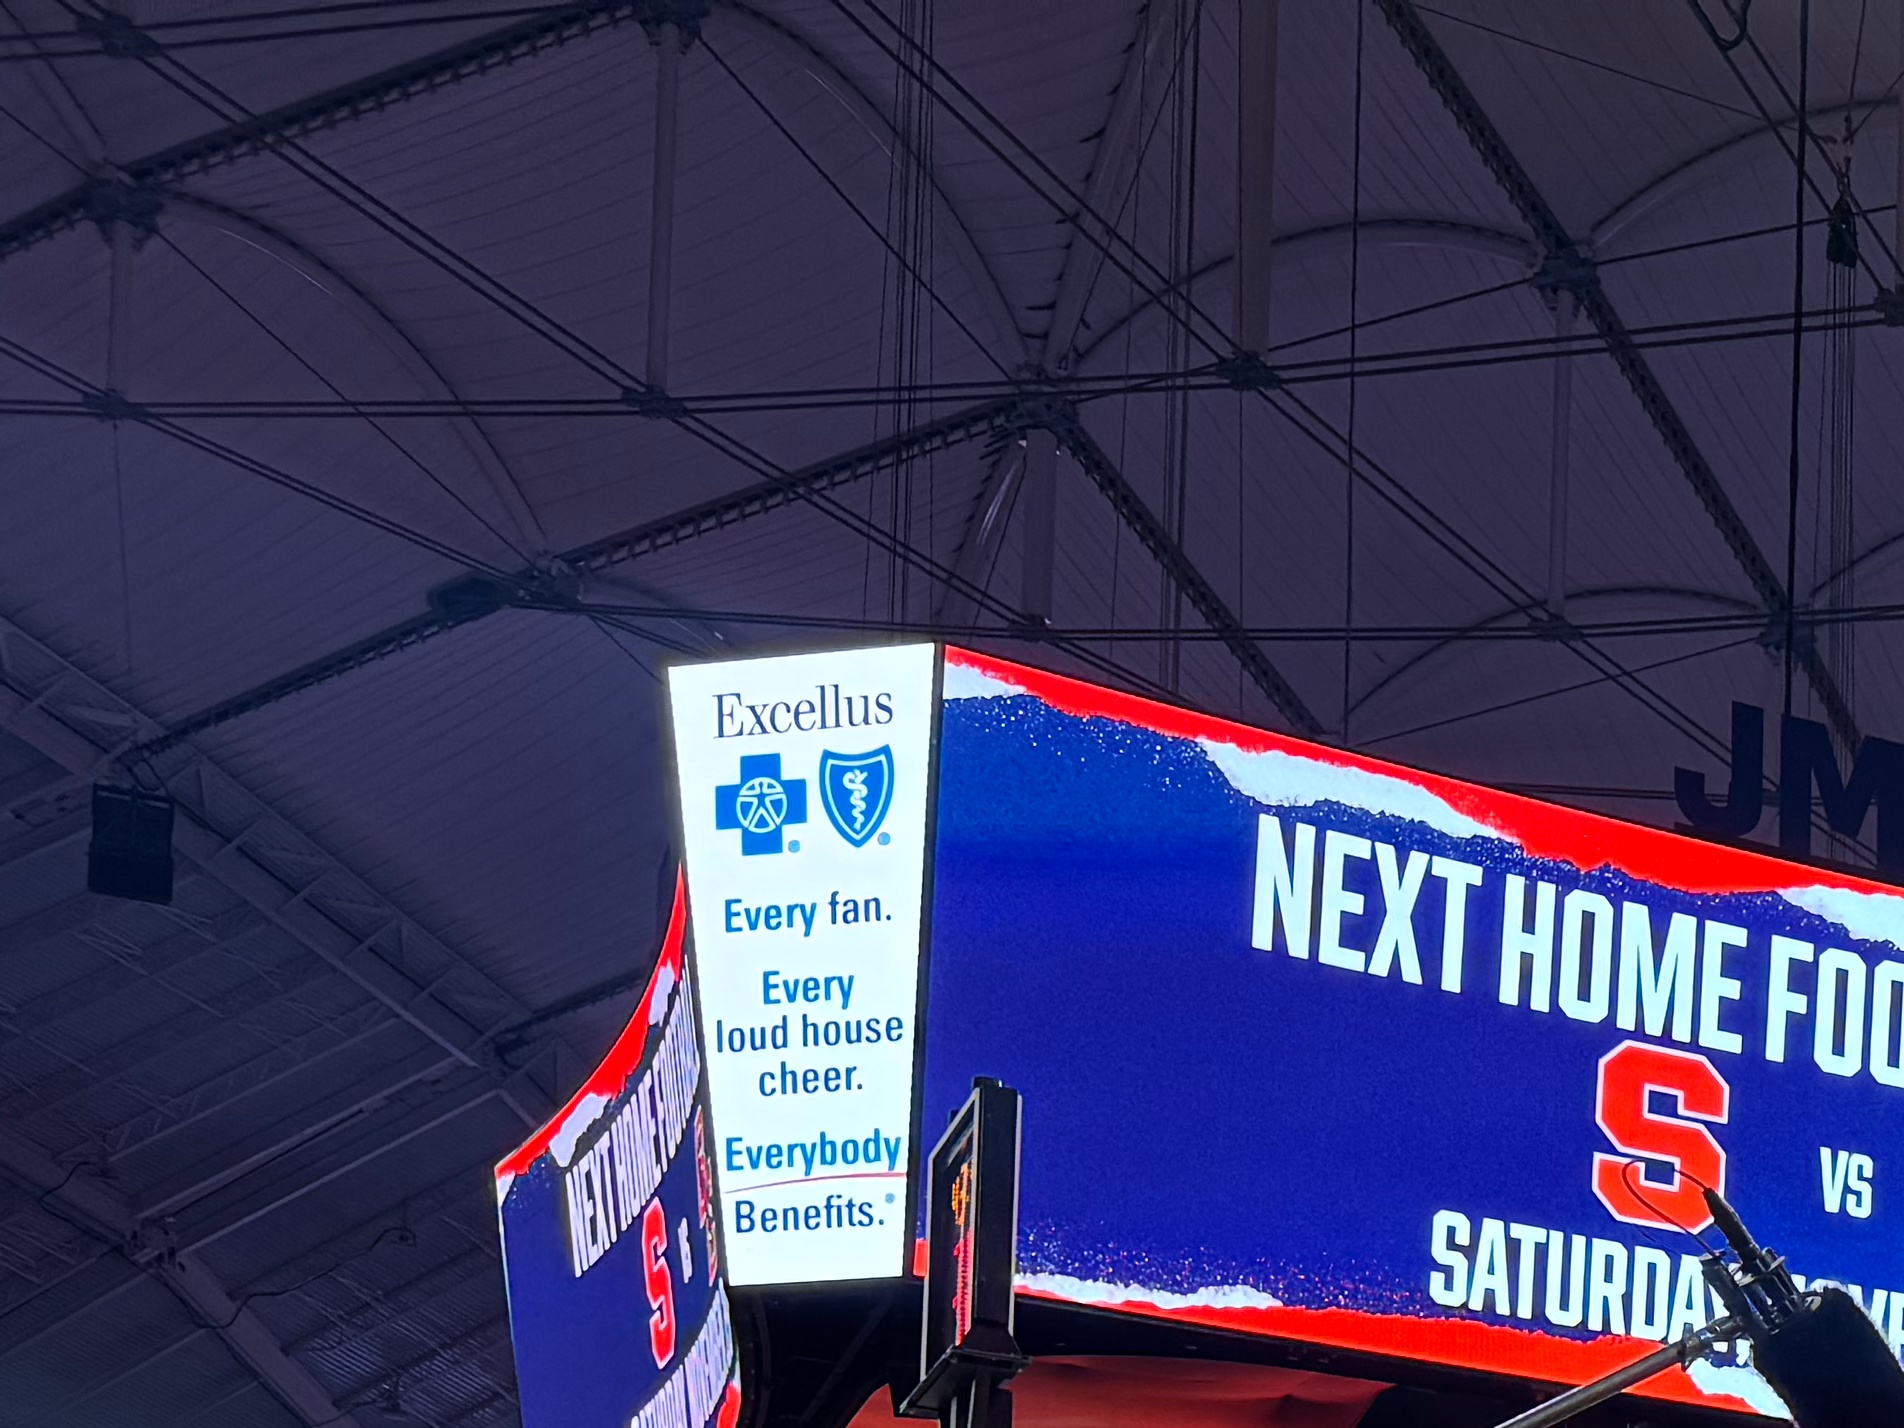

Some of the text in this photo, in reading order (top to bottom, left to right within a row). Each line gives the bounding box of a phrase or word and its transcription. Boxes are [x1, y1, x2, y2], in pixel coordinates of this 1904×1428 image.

[714, 686, 894, 739] Excellus
[724, 891, 893, 938] Every fan.
[1252, 813, 1482, 994] NEXT
[1498, 873, 1747, 1056] HOME
[761, 970, 855, 1009] Every
[716, 1014, 904, 1055] loud house
[757, 1062, 864, 1098] cheer.
[725, 1128, 902, 1174] Everybody
[1593, 1038, 1874, 1235] S VS
[565, 1131, 611, 1279] NEXT
[641, 1197, 675, 1369] S
